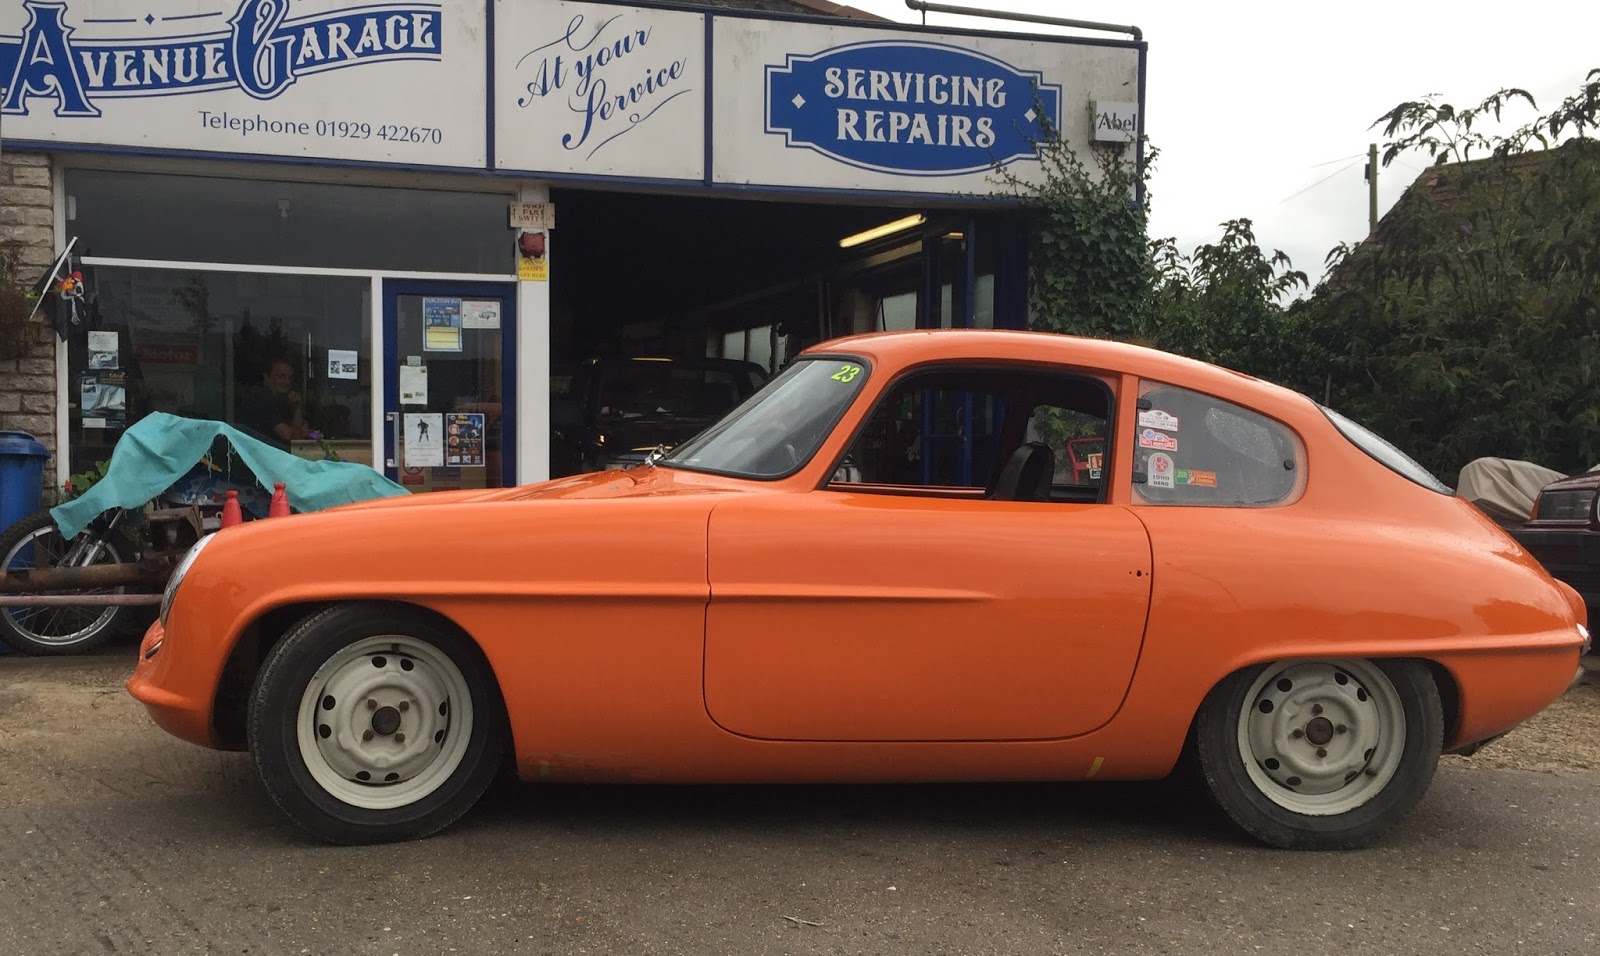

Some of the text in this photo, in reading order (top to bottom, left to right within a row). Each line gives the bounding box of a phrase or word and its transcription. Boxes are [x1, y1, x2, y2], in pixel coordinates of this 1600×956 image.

[1, 0, 436, 117] AVENUE GARAGE
[517, 25, 652, 108] At your
[562, 57, 687, 150] Service
[824, 67, 1007, 109] SERVICING
[198, 110, 443, 145] Telephone 01929 422670
[836, 108, 996, 148] REPAIRS
[1097, 111, 1136, 132] Abel
[830, 364, 861, 382] 23
